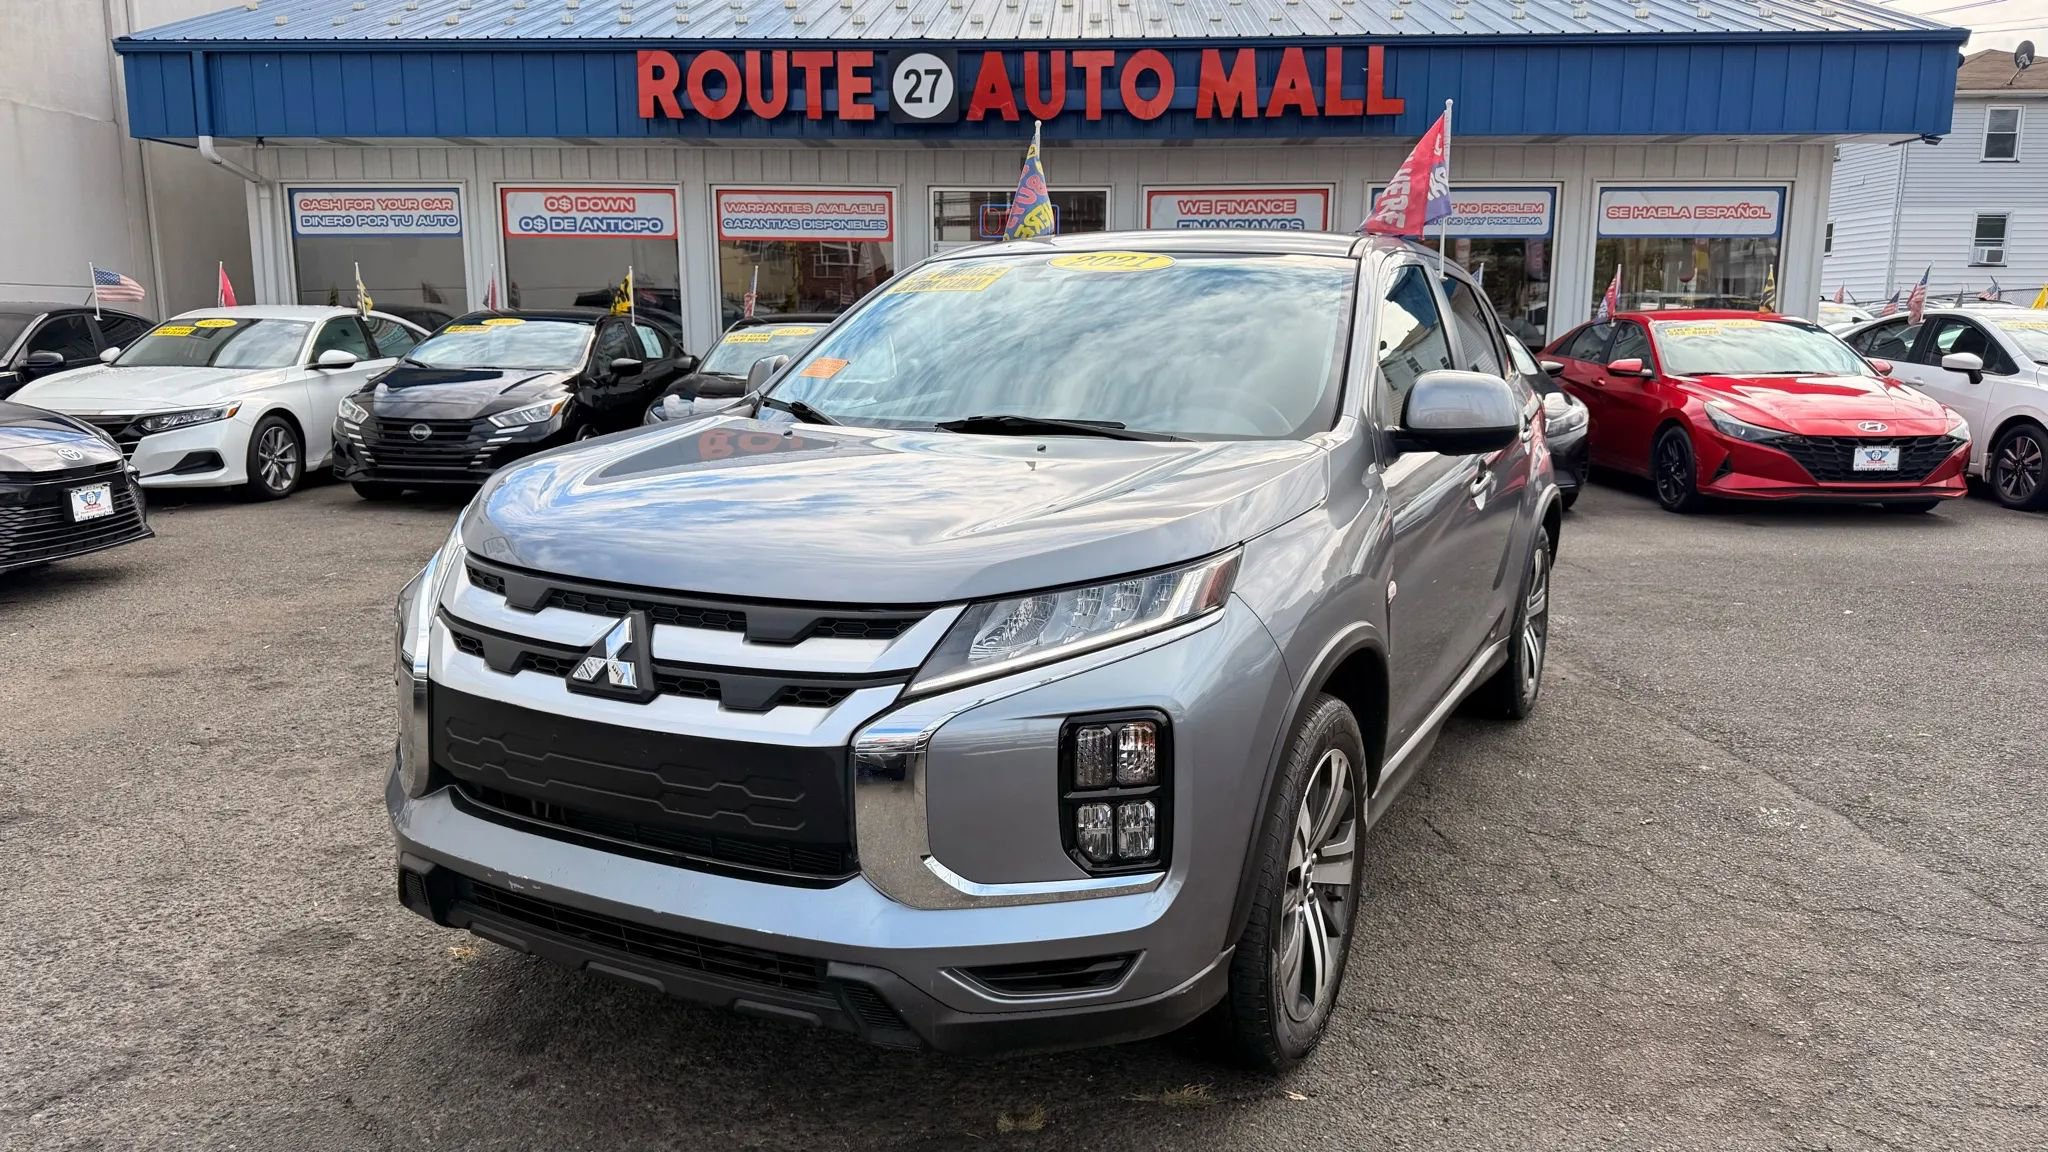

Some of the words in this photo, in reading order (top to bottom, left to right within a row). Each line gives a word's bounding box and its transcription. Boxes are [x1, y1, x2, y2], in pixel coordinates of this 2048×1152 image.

[636, 49, 876, 121] ROUTE
[903, 68, 943, 104] 27
[966, 48, 1176, 121] AUTO
[1196, 45, 1405, 119] MALL
[300, 198, 345, 211] CASH
[344, 198, 375, 211] FOR
[378, 198, 419, 211] YOUR
[420, 198, 454, 211] CAR
[576, 197, 636, 212] DOWN
[724, 201, 813, 214] WARRANTIES
[815, 202, 886, 214] AVAILABLE
[1177, 199, 1212, 215] WE
[1214, 199, 1297, 215] FINANCE
[1458, 203, 1480, 214] NO
[1481, 203, 1544, 214] PROBLEM
[1607, 205, 1632, 219] SE
[1632, 205, 1691, 219] HABLA
[1694, 202, 1771, 219] ESPAÑOL
[301, 214, 354, 227] DINERO
[357, 214, 388, 227] POR
[390, 214, 414, 227] TU
[415, 214, 459, 227] AUTO
[550, 216, 577, 232] DE
[579, 217, 664, 233] ANTICIPO
[722, 218, 800, 230] GARANTIAS
[802, 219, 888, 231] DISPONIBLES
[1463, 216, 1486, 225] HAY
[1487, 216, 1543, 225] PROBLEMA
[1071, 253, 1159, 267] 2021
